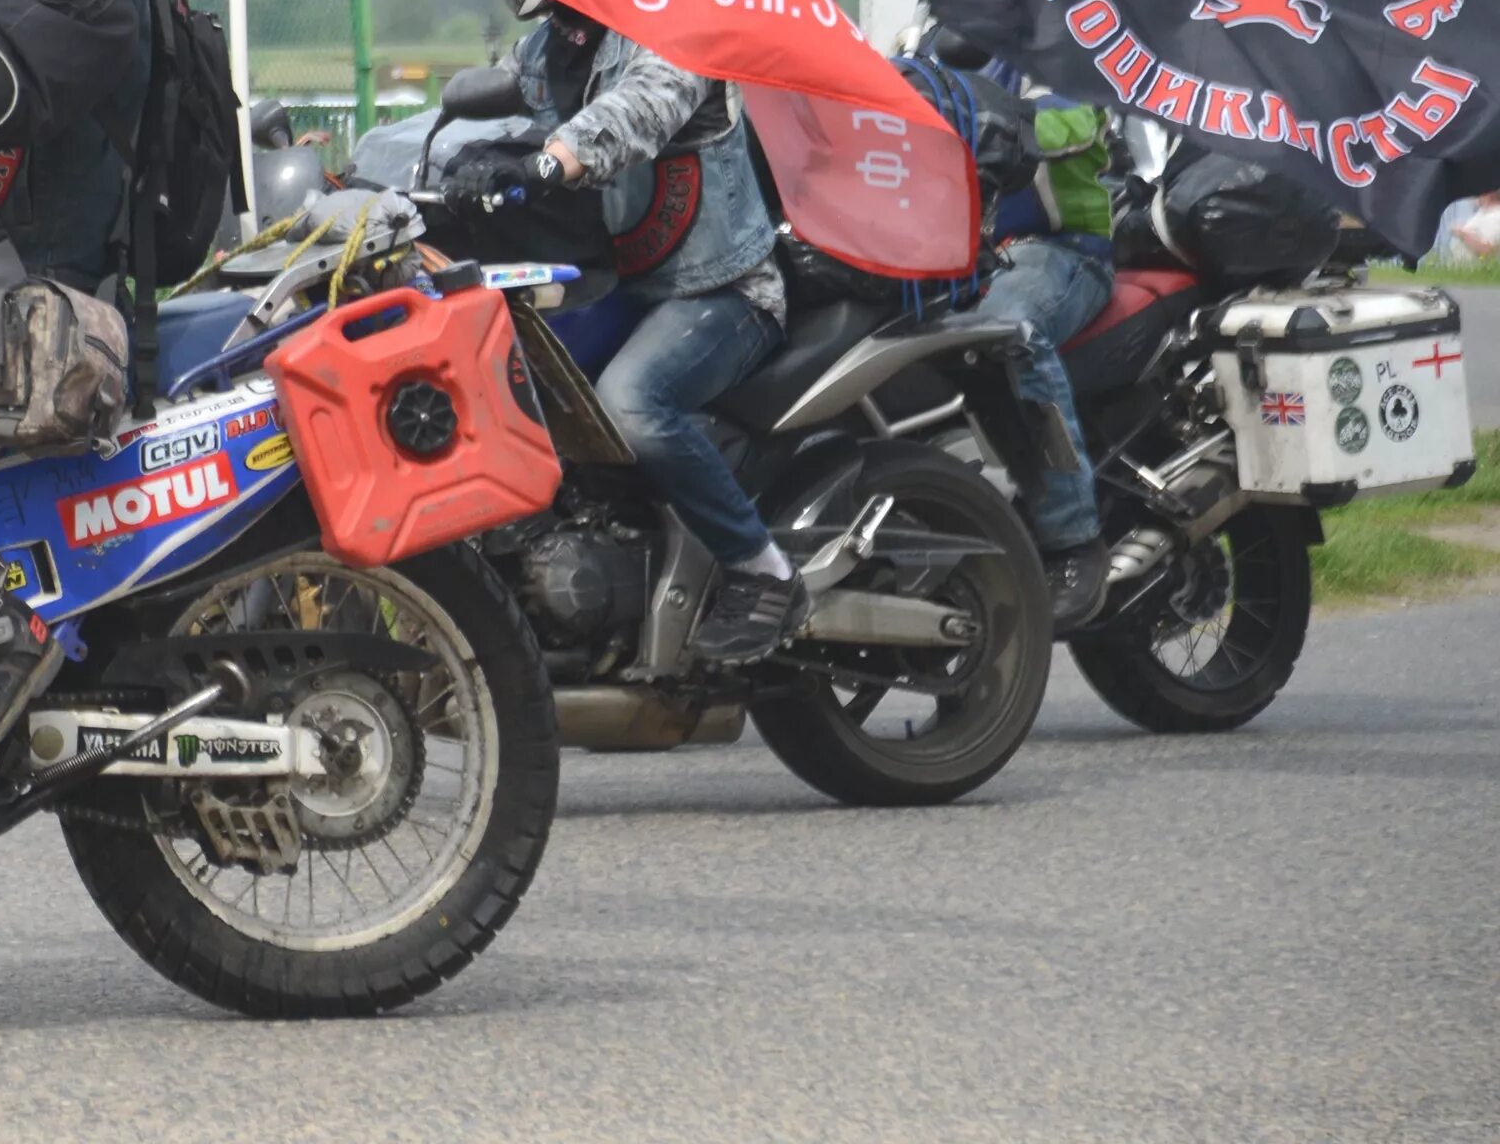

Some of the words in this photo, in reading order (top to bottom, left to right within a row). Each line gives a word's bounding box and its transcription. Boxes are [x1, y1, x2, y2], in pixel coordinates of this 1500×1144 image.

[1375, 360, 1397, 383] PL
[150, 430, 210, 464] agv
[74, 461, 230, 541] MOTUL
[199, 739, 282, 756] MONSTER
